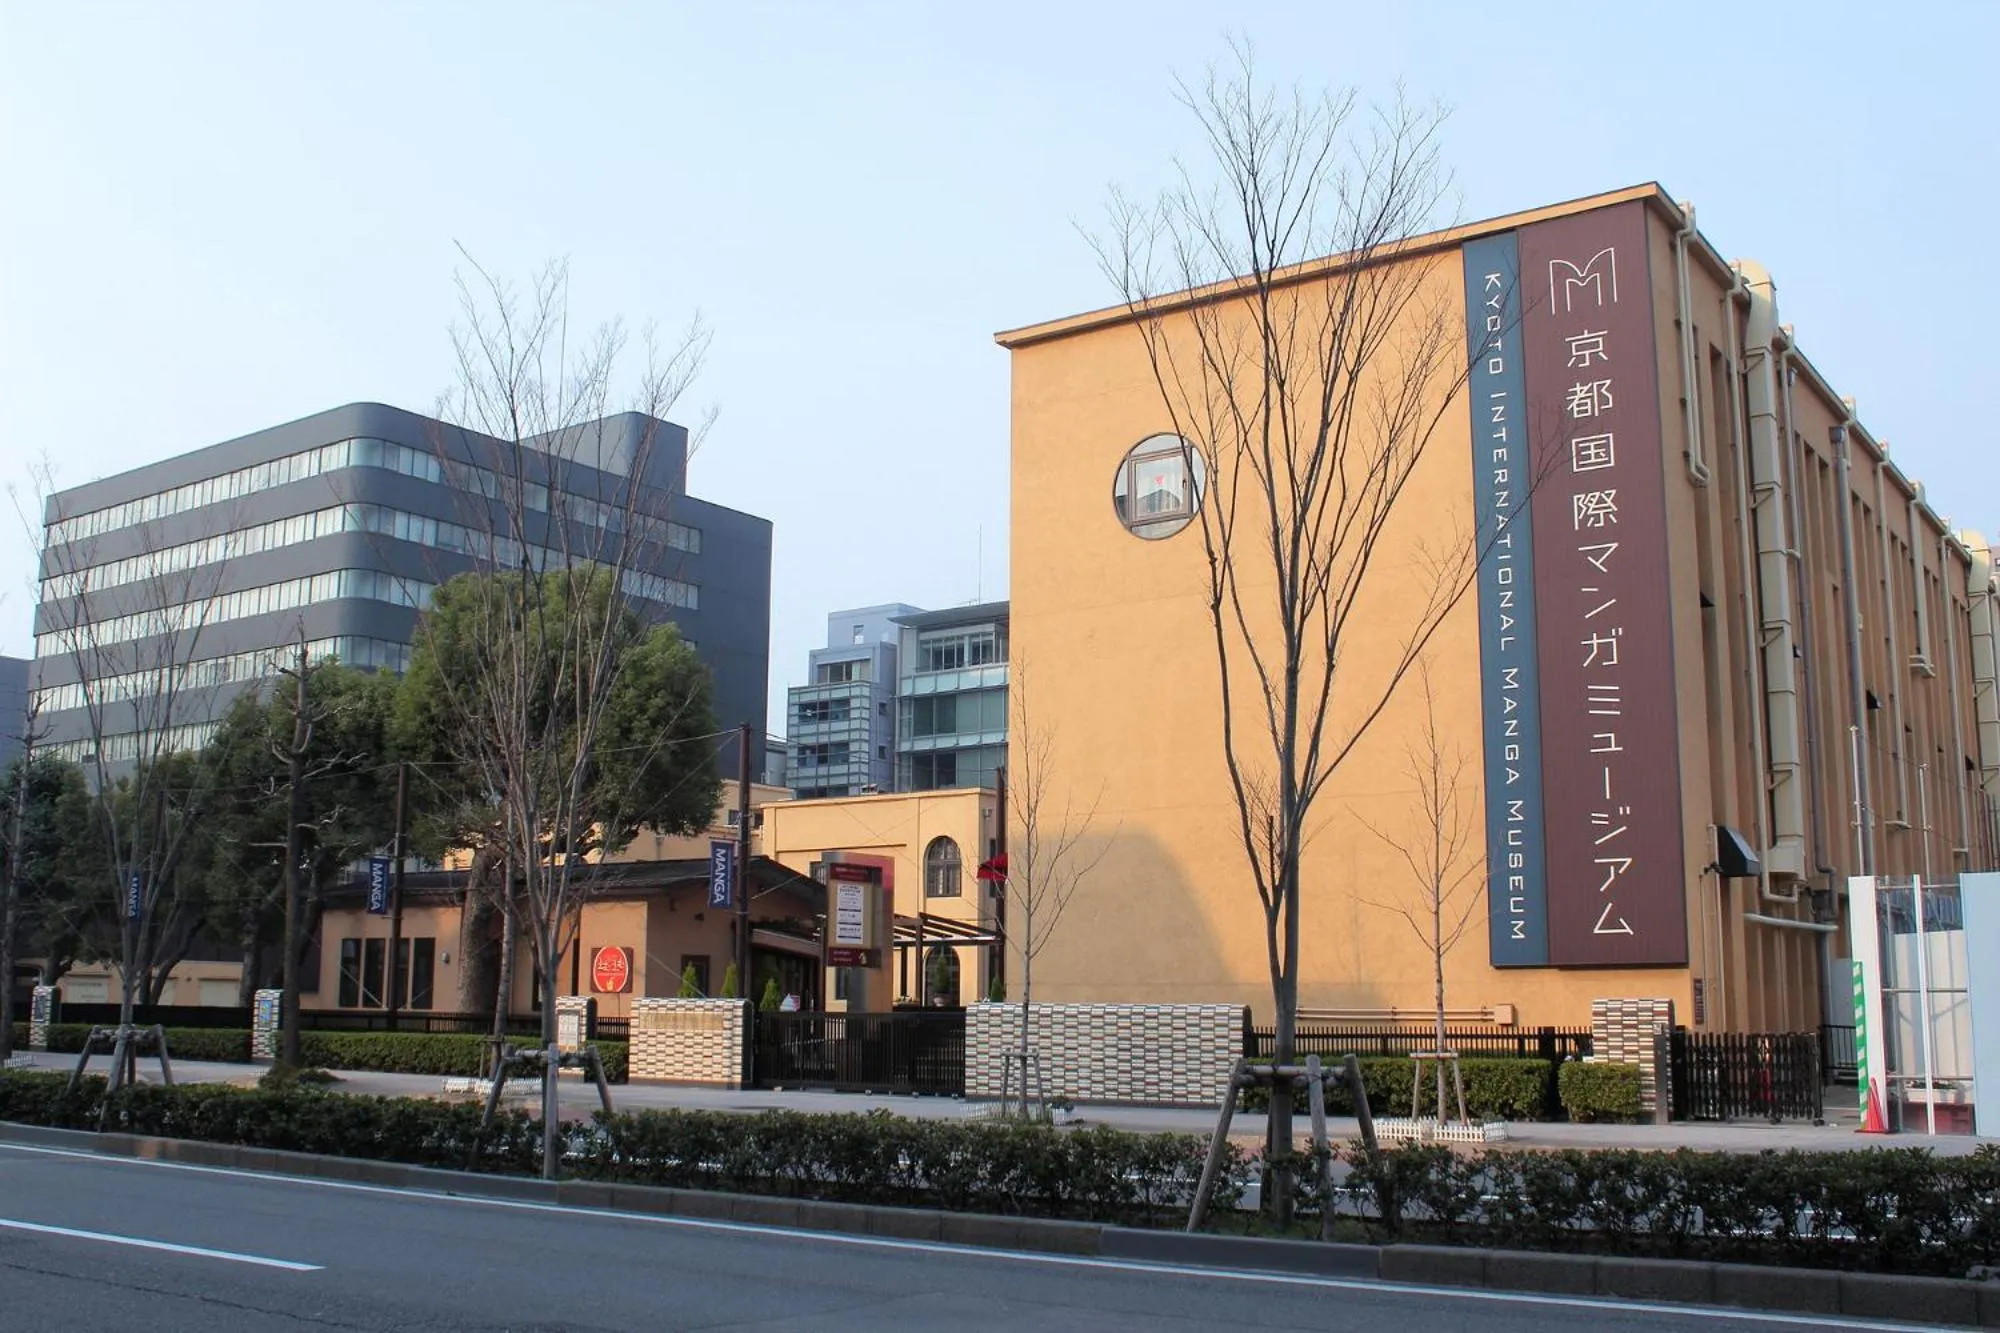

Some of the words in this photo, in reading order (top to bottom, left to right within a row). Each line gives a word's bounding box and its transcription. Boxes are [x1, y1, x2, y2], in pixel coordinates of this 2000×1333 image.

[1484, 273, 1504, 375] KYOTO
[1490, 392, 1515, 651] INTERNATIONAL
[1565, 329, 1633, 936] 京都国際マンガミュージアム
[1502, 668, 1520, 785] MANGA
[370, 863, 384, 911] MANGA
[713, 848, 727, 904] MANGA
[1507, 799, 1526, 939] MUSEUM
